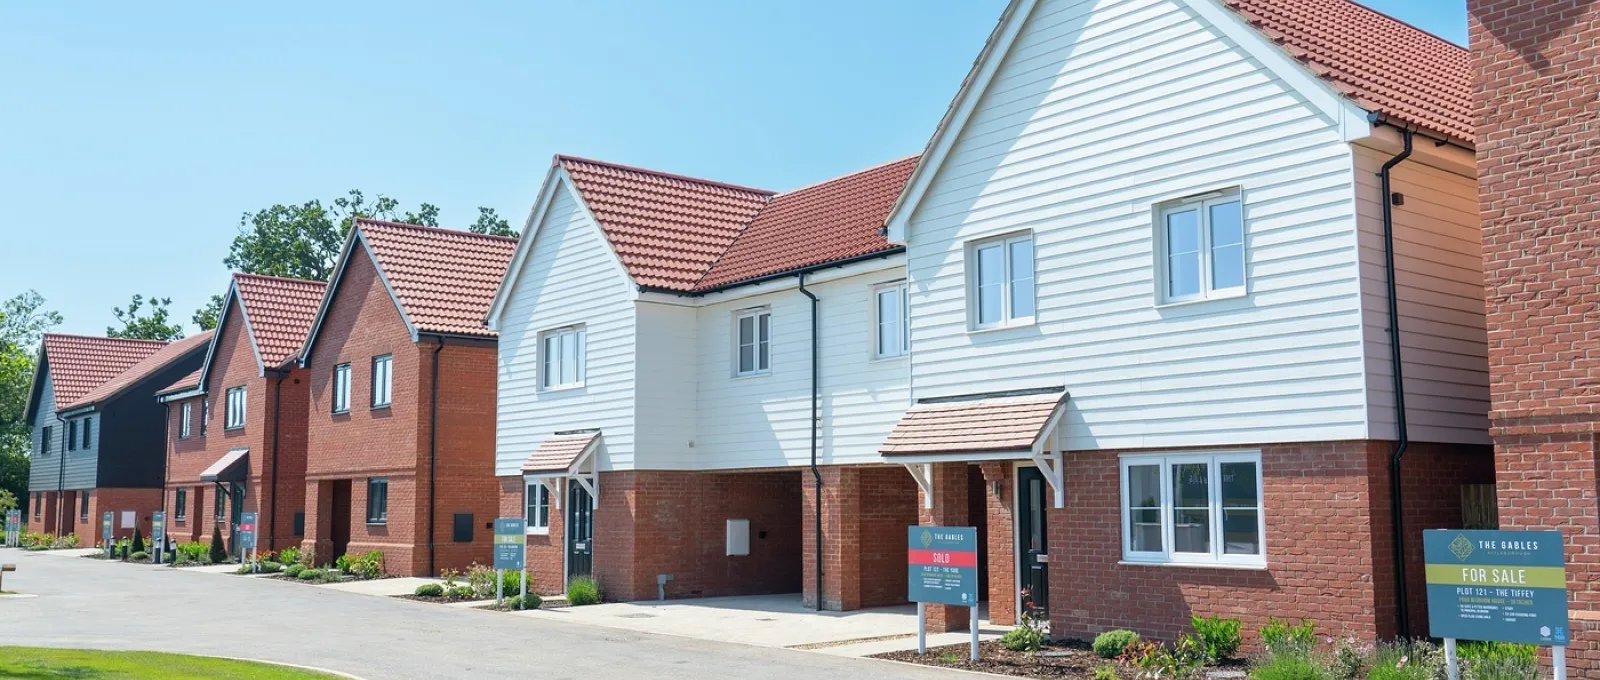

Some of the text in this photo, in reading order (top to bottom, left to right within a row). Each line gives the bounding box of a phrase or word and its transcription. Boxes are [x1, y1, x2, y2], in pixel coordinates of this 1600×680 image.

[1478, 540, 1538, 550] THE GABLES
[933, 552, 950, 564] SOLD
[1462, 568, 1526, 584] FOR SALE
[1456, 587, 1473, 596] PLOT
[1475, 588, 1488, 596] 121
[1496, 588, 1508, 597] THE
[1511, 589, 1535, 598] TIFFEY
